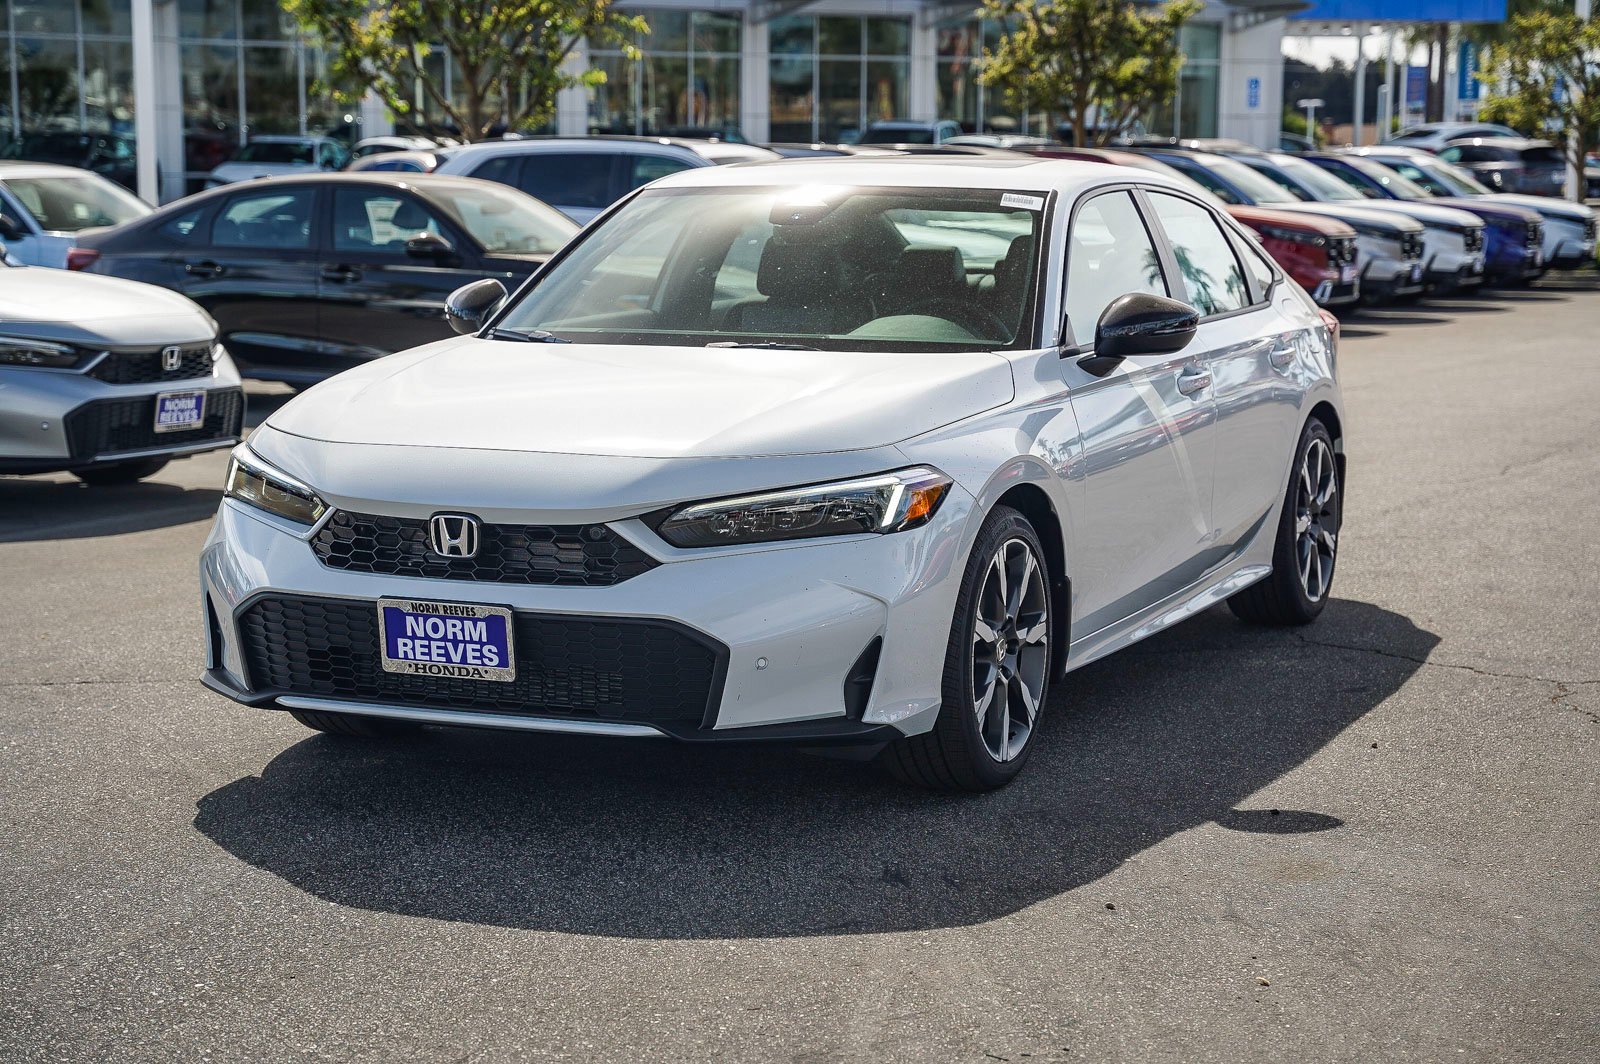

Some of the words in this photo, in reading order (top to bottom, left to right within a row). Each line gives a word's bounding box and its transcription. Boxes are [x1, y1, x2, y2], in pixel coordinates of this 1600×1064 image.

[410, 602, 440, 615] NORM
[443, 606, 477, 617] REEVES
[405, 616, 487, 642] NORM
[397, 637, 499, 666] REEVES
